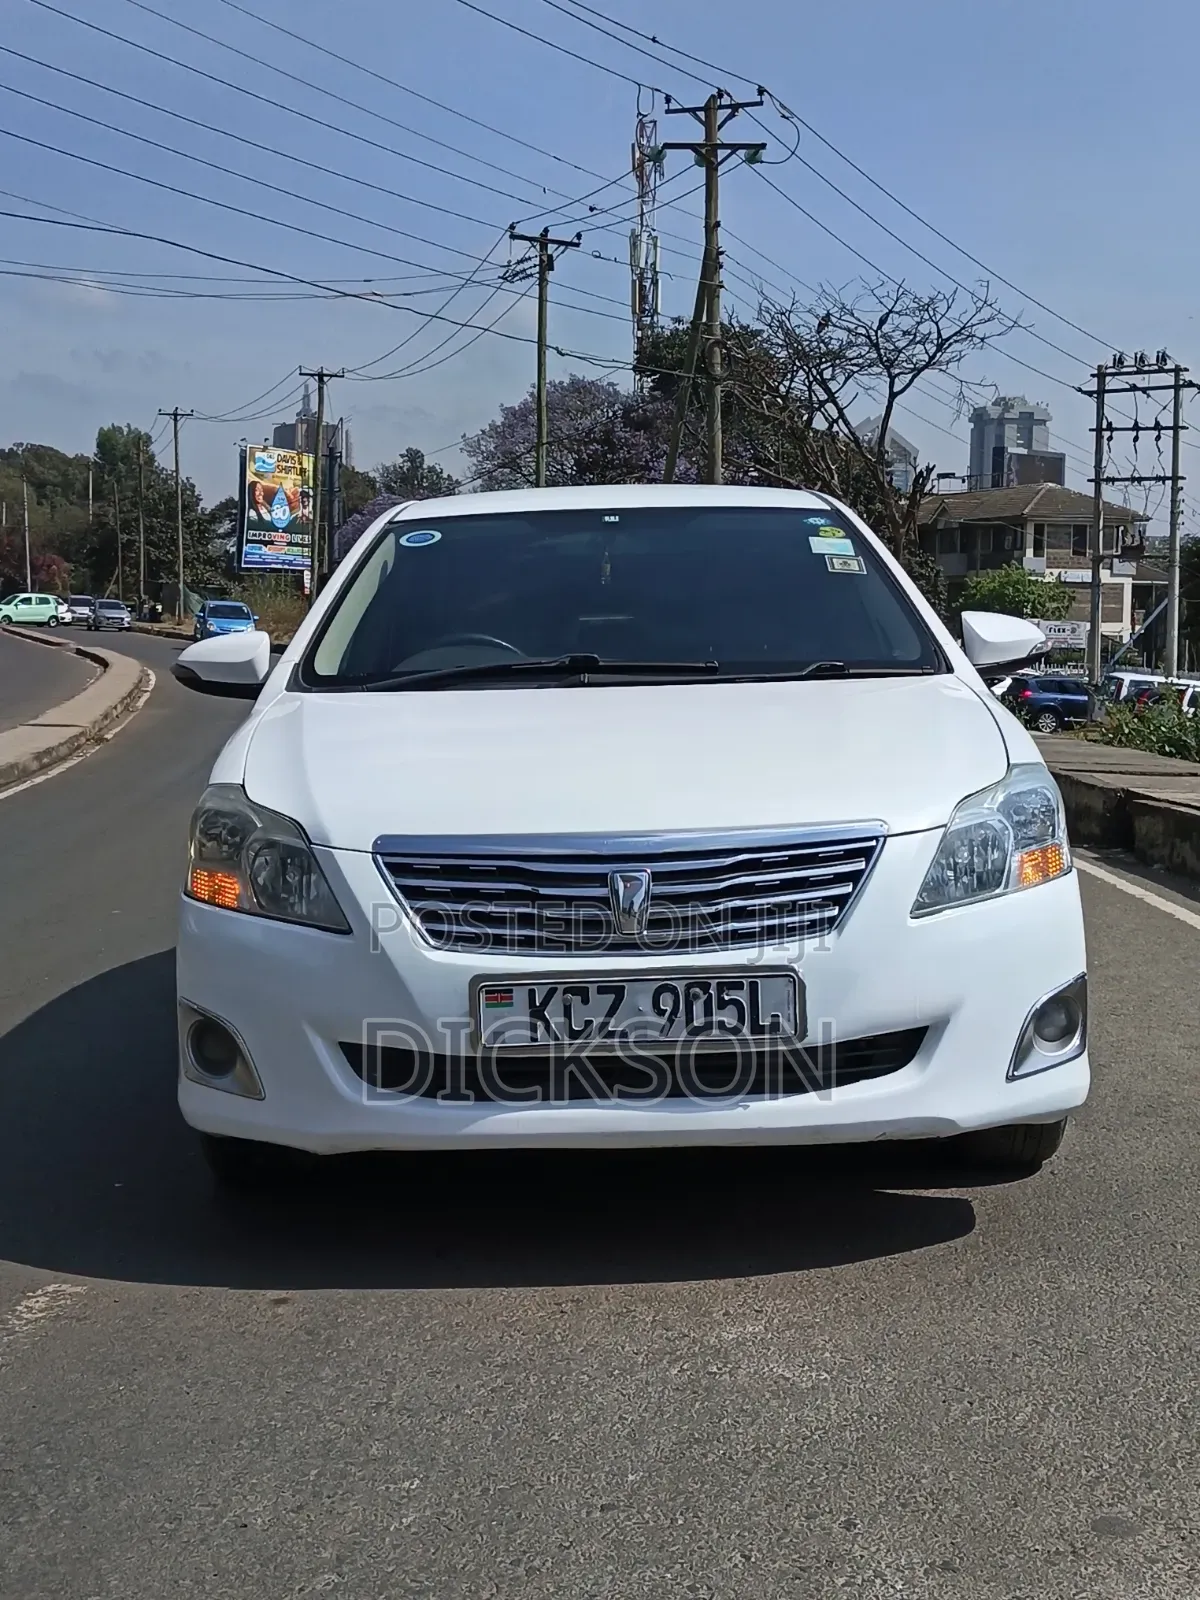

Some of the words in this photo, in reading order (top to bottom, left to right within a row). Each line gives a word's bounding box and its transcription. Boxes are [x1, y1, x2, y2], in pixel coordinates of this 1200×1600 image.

[277, 454, 296, 465] DAVIS
[248, 531, 290, 541] IMPROVING
[528, 984, 629, 1042] KCZ
[652, 980, 781, 1038] 905L
